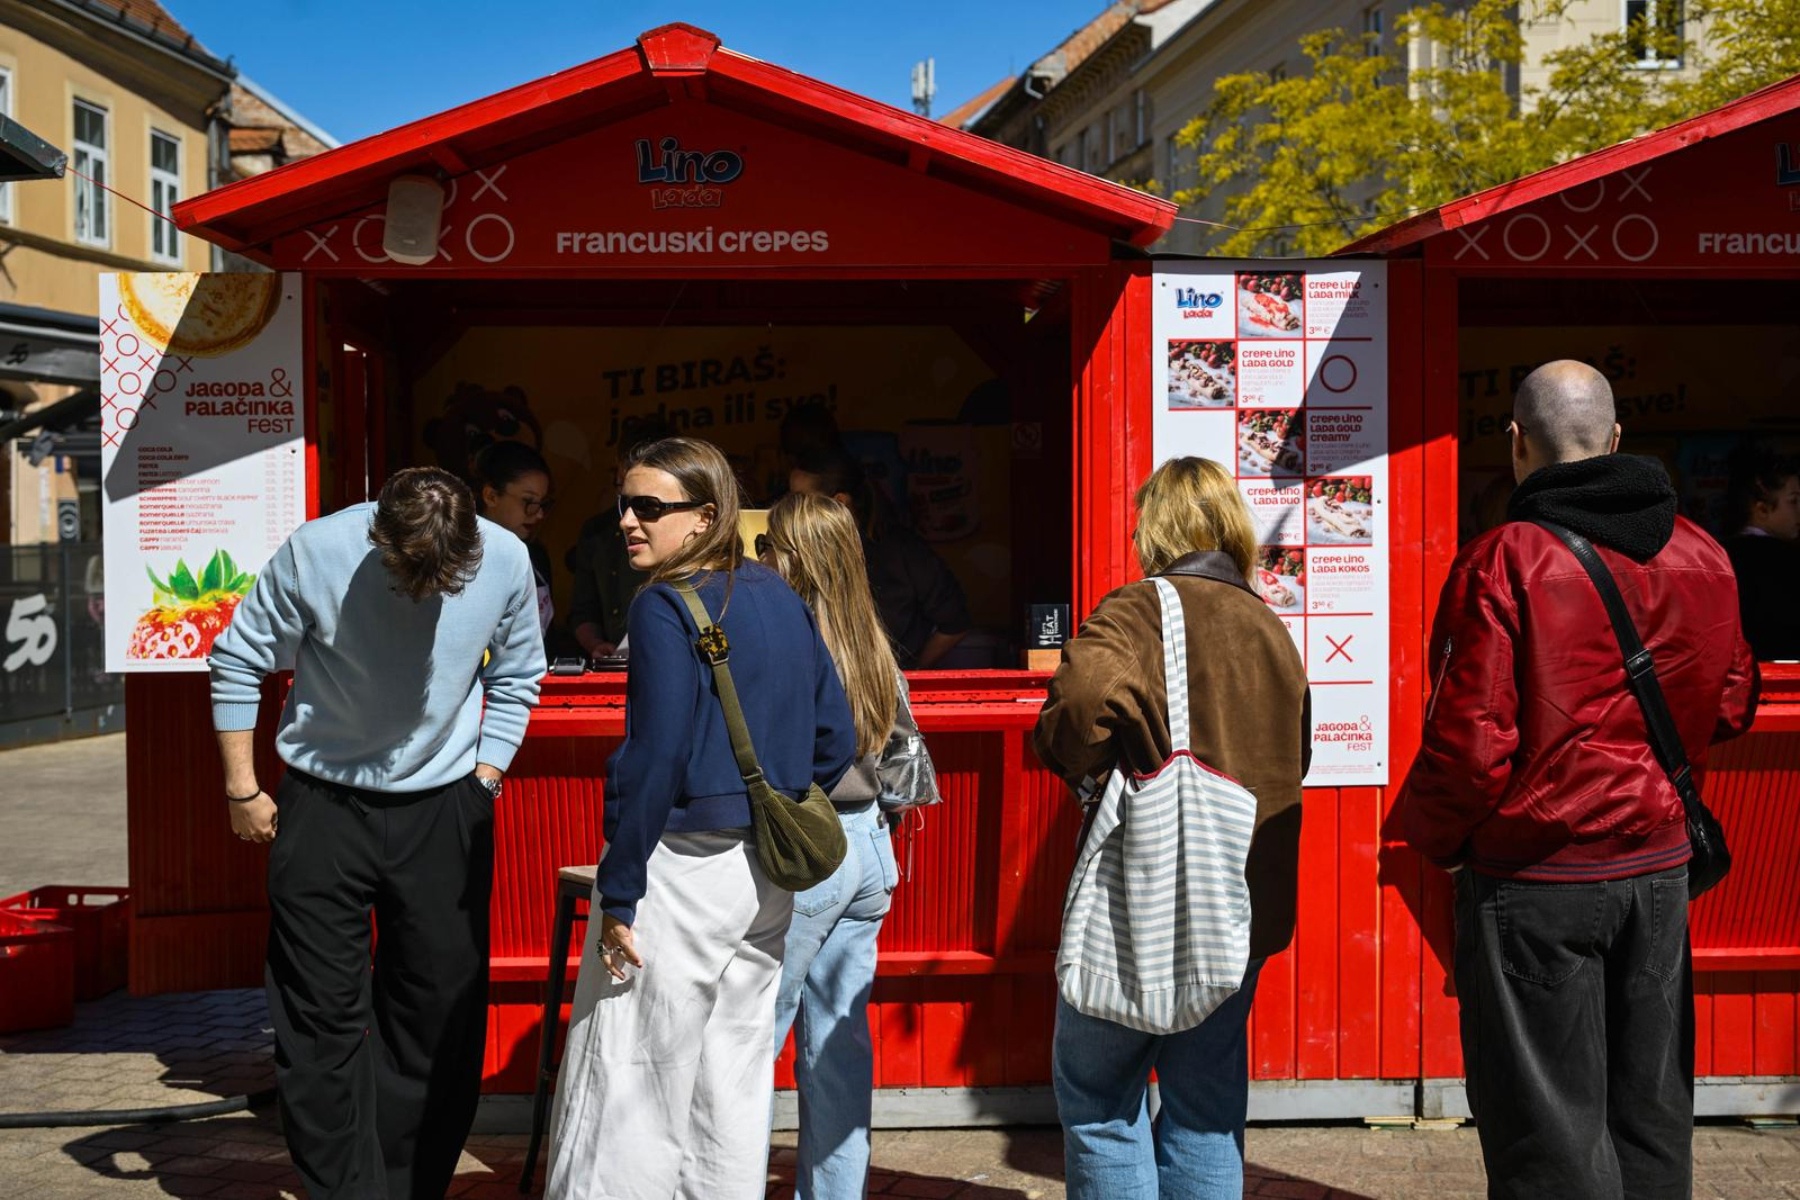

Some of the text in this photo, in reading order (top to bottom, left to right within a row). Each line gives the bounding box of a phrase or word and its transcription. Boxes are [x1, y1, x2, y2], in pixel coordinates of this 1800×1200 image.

[634, 137, 743, 183] Lino
[651, 184, 722, 209] Lada
[556, 226, 829, 254] Francuski crepes
[1175, 287, 1223, 309] Lino
[1183, 309, 1214, 319] Lada
[269, 368, 294, 398] &
[603, 366, 644, 400] TI
[1359, 714, 1373, 731] &
